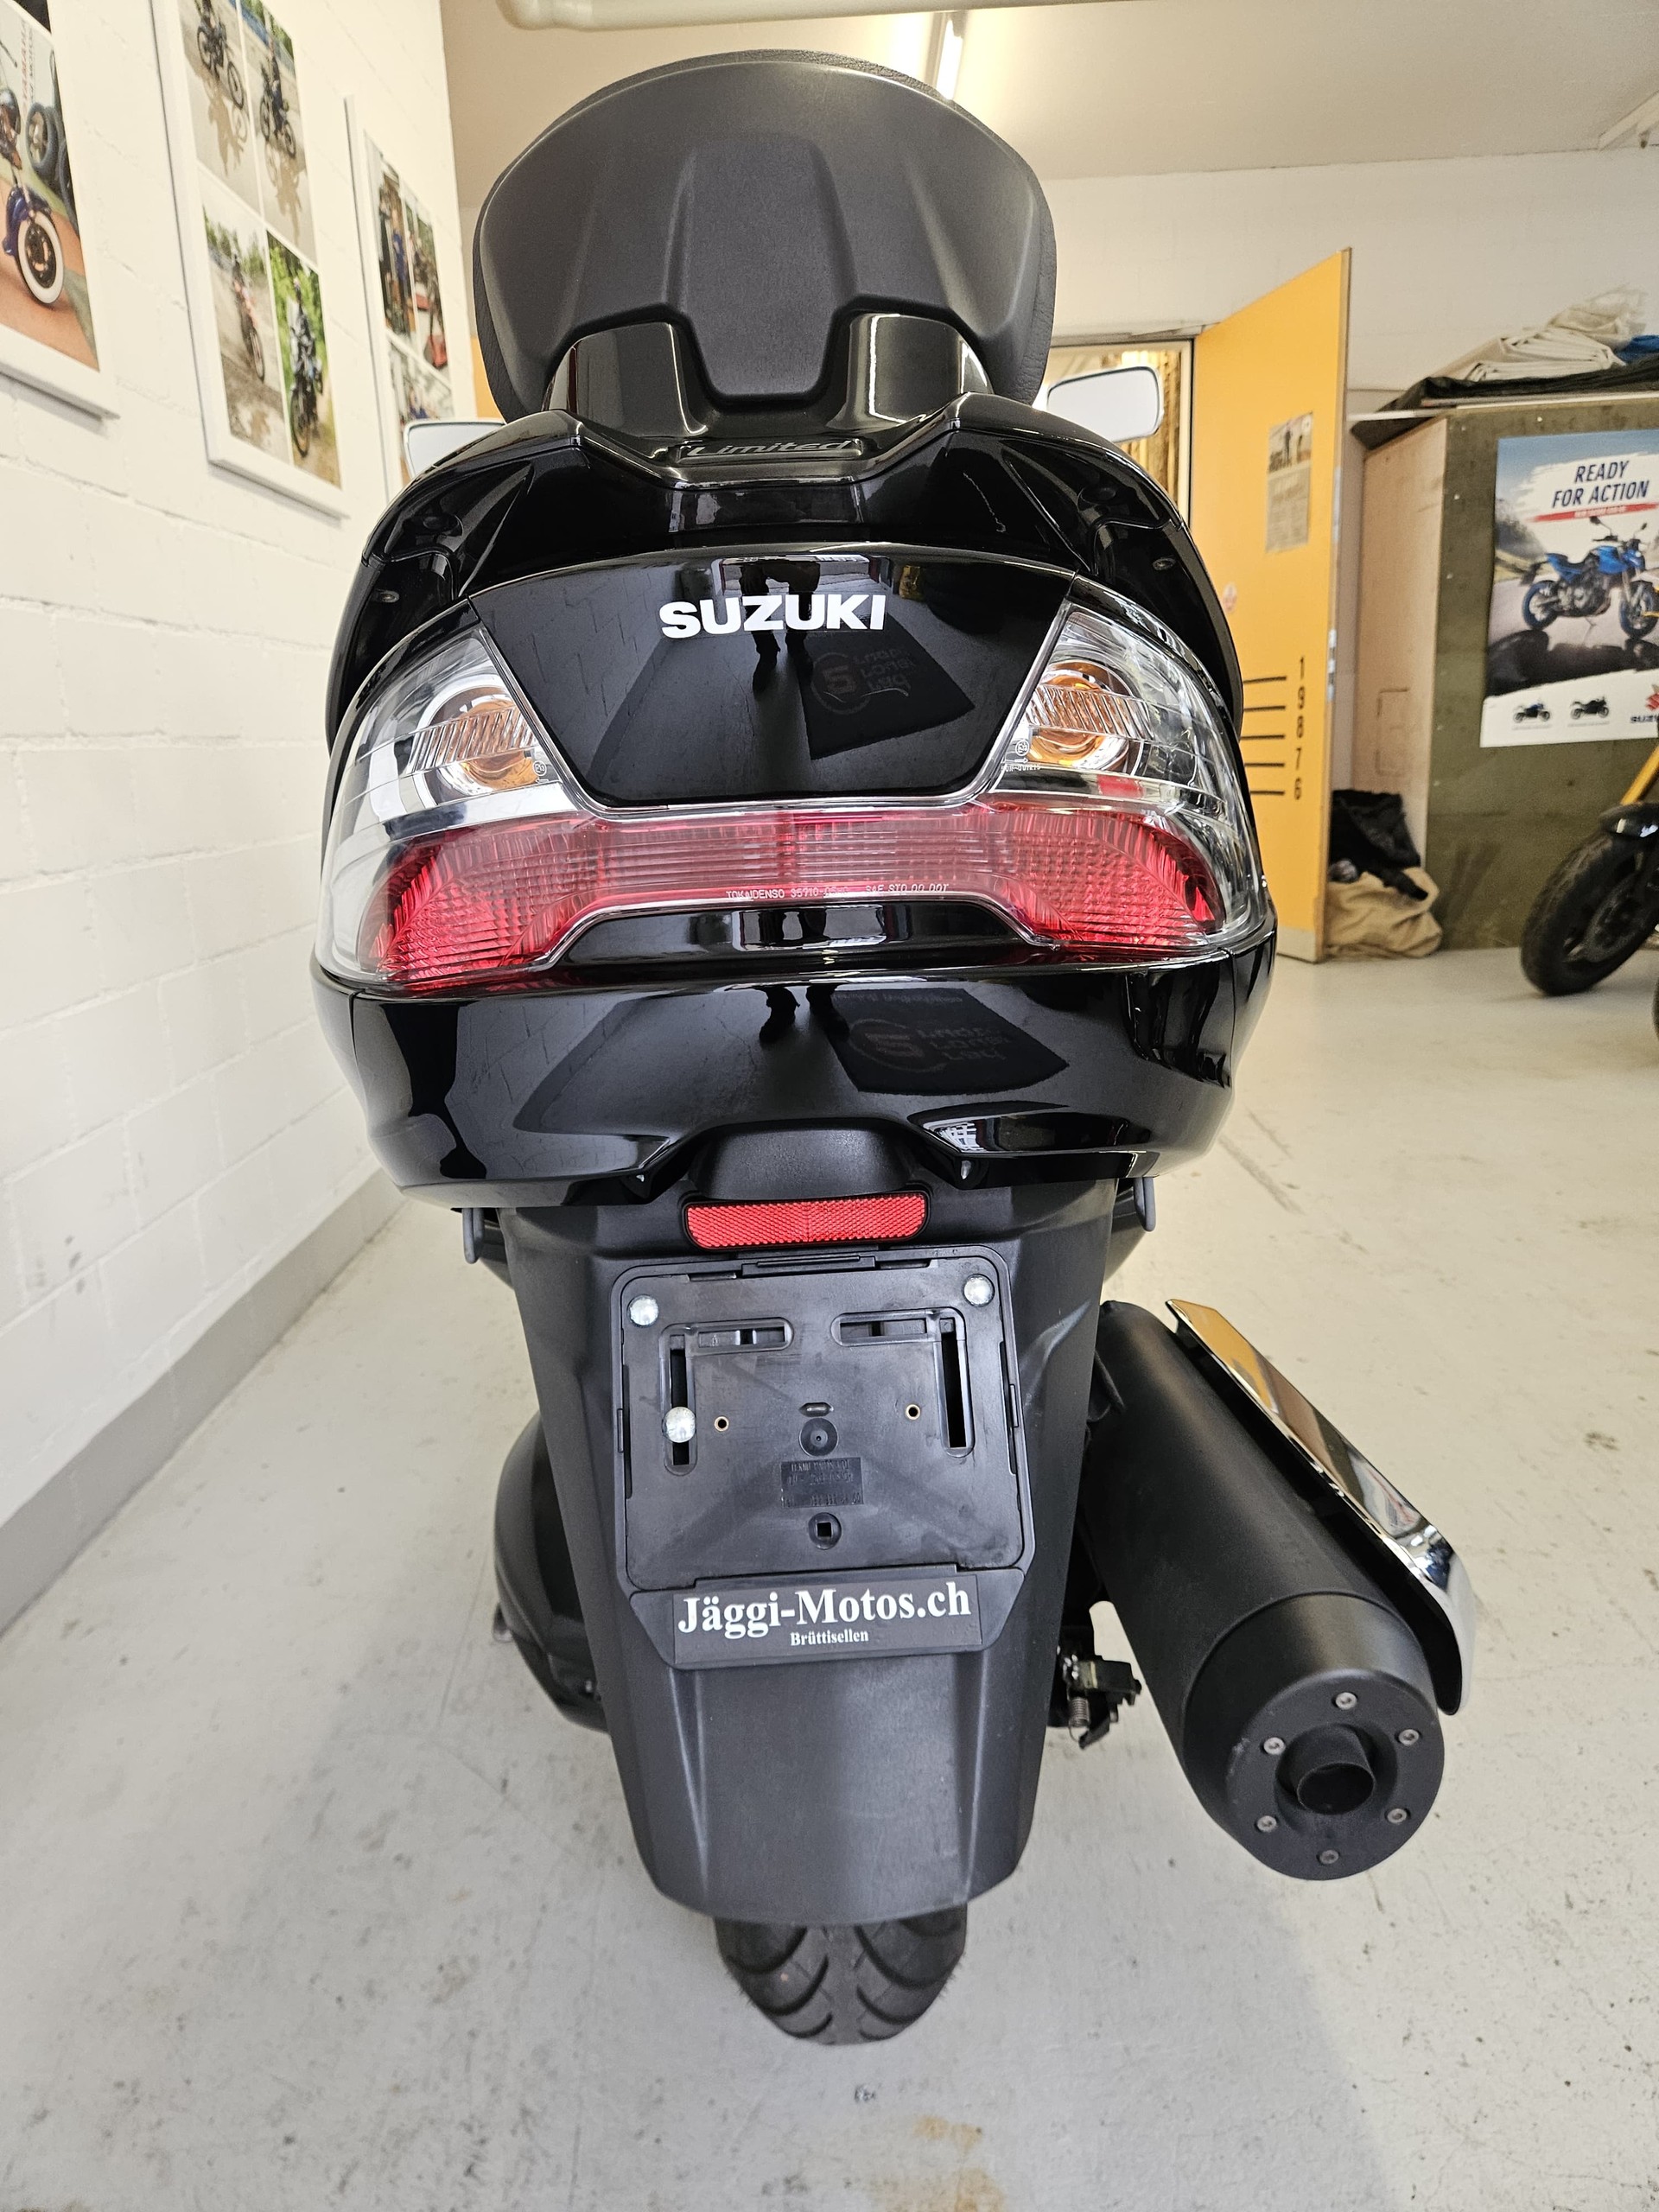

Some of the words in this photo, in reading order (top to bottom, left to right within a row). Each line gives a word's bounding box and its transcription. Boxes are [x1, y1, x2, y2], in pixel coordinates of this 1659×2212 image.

[688, 440, 851, 456] Limited
[1574, 461, 1630, 483] READY
[1552, 488, 1584, 508] FOR
[1588, 480, 1649, 504] ACTION
[659, 594, 887, 639] SUZUKI
[726, 888, 785, 899] TOKAIDENSO
[678, 1582, 971, 1639] Jäggi-Motos.ch
[790, 1629, 869, 1646] Brüttisellen
